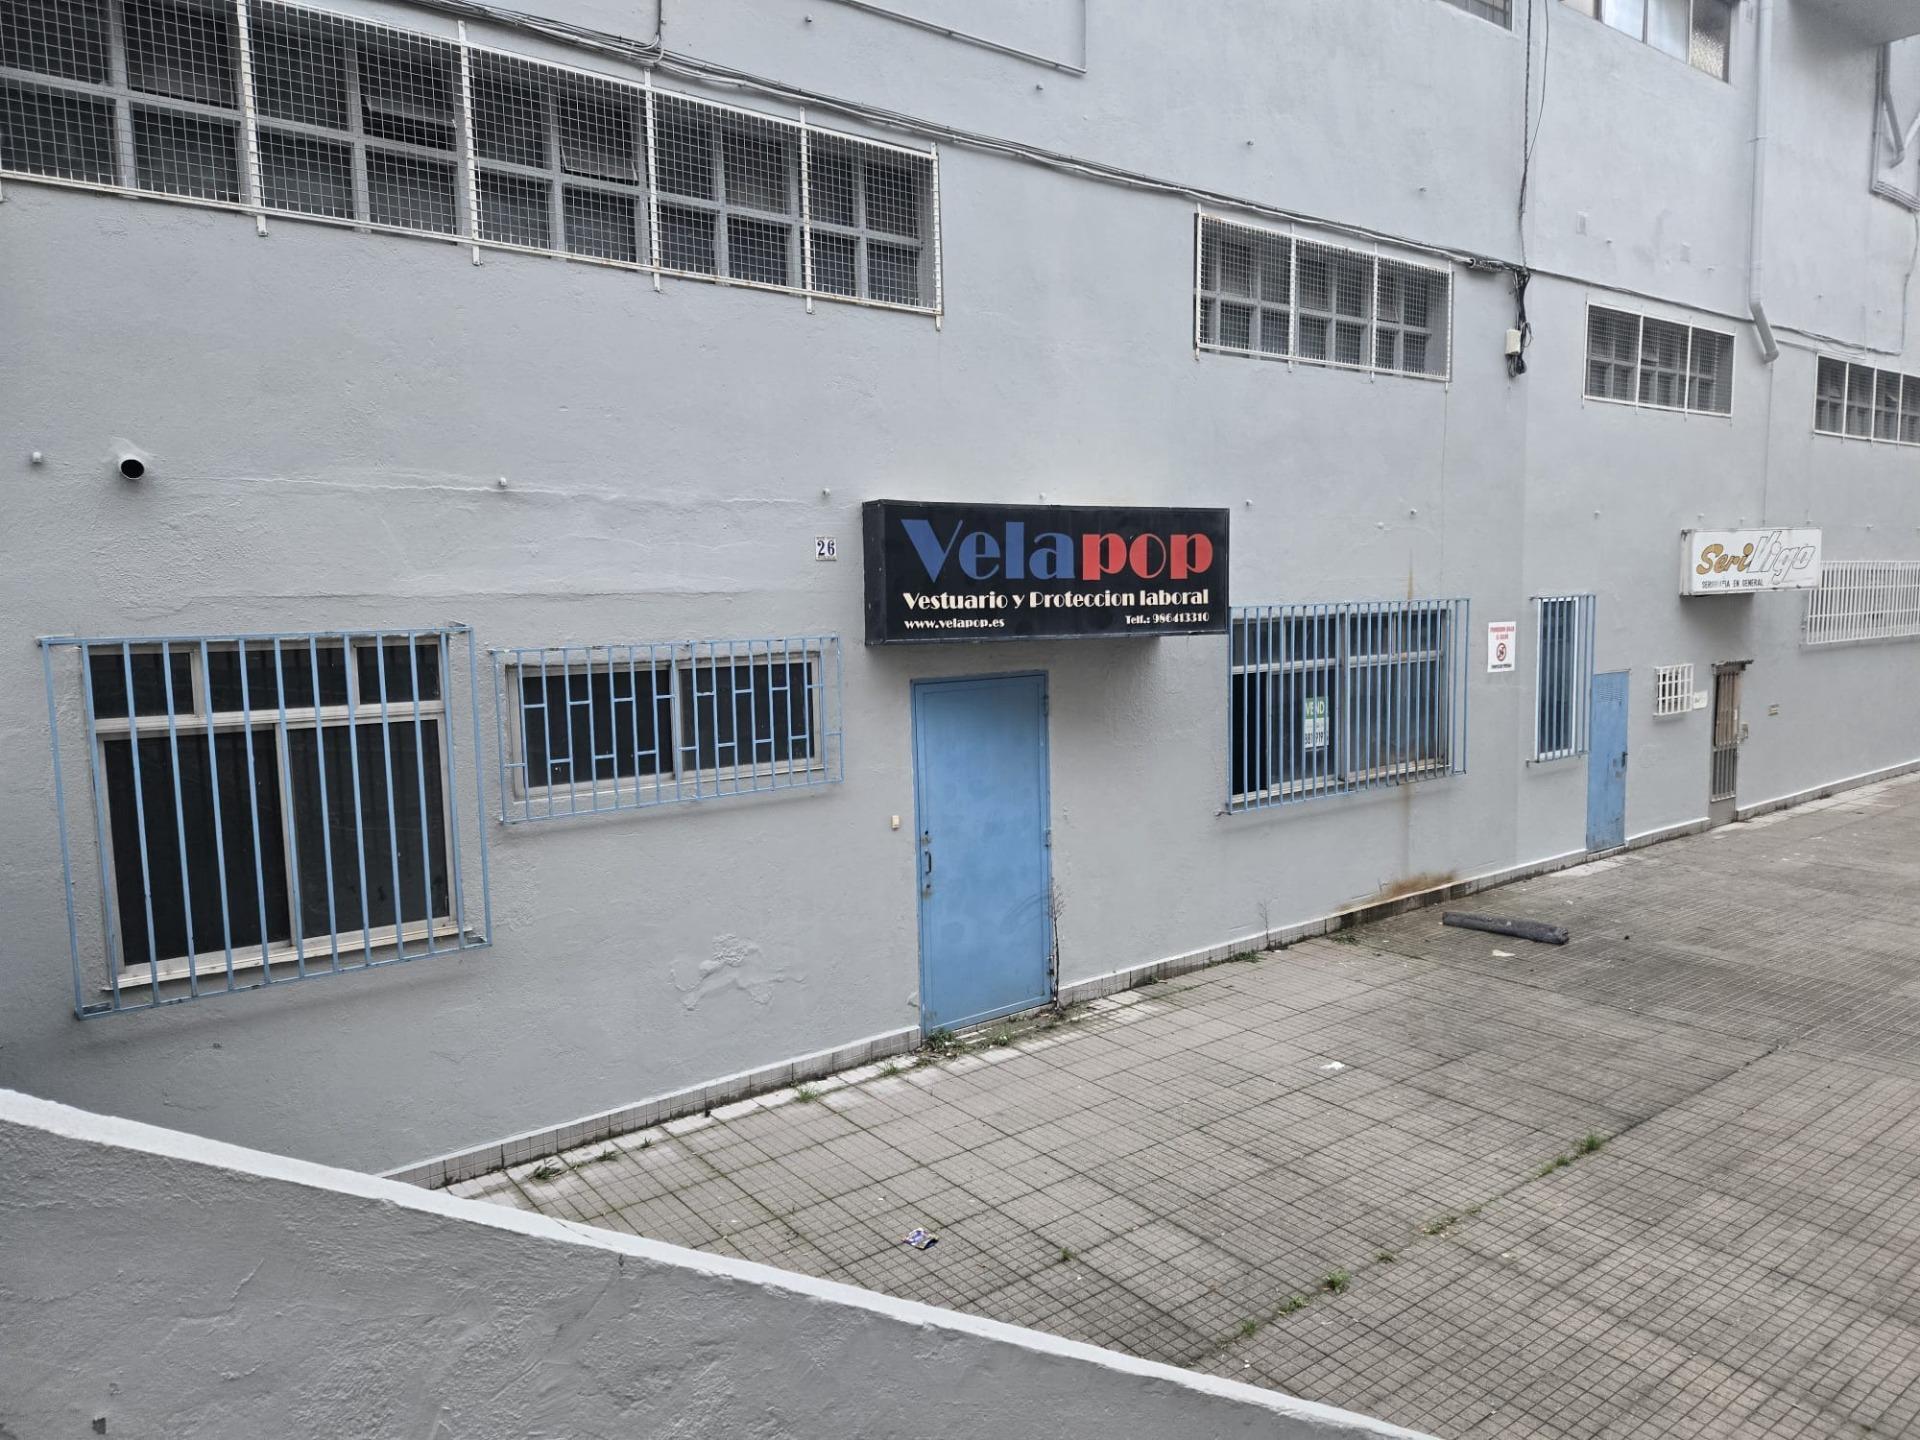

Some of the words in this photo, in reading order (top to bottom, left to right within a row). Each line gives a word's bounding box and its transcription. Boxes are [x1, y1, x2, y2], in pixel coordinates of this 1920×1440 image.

[817, 540, 835, 556] 26
[903, 591, 1008, 610] Vestuario
[1012, 595, 1026, 609] y
[1029, 590, 1135, 608] Proteccion
[1140, 589, 1209, 606] laboral
[904, 618, 1006, 629] www.velapop.es
[1152, 612, 1210, 623] 986413310
